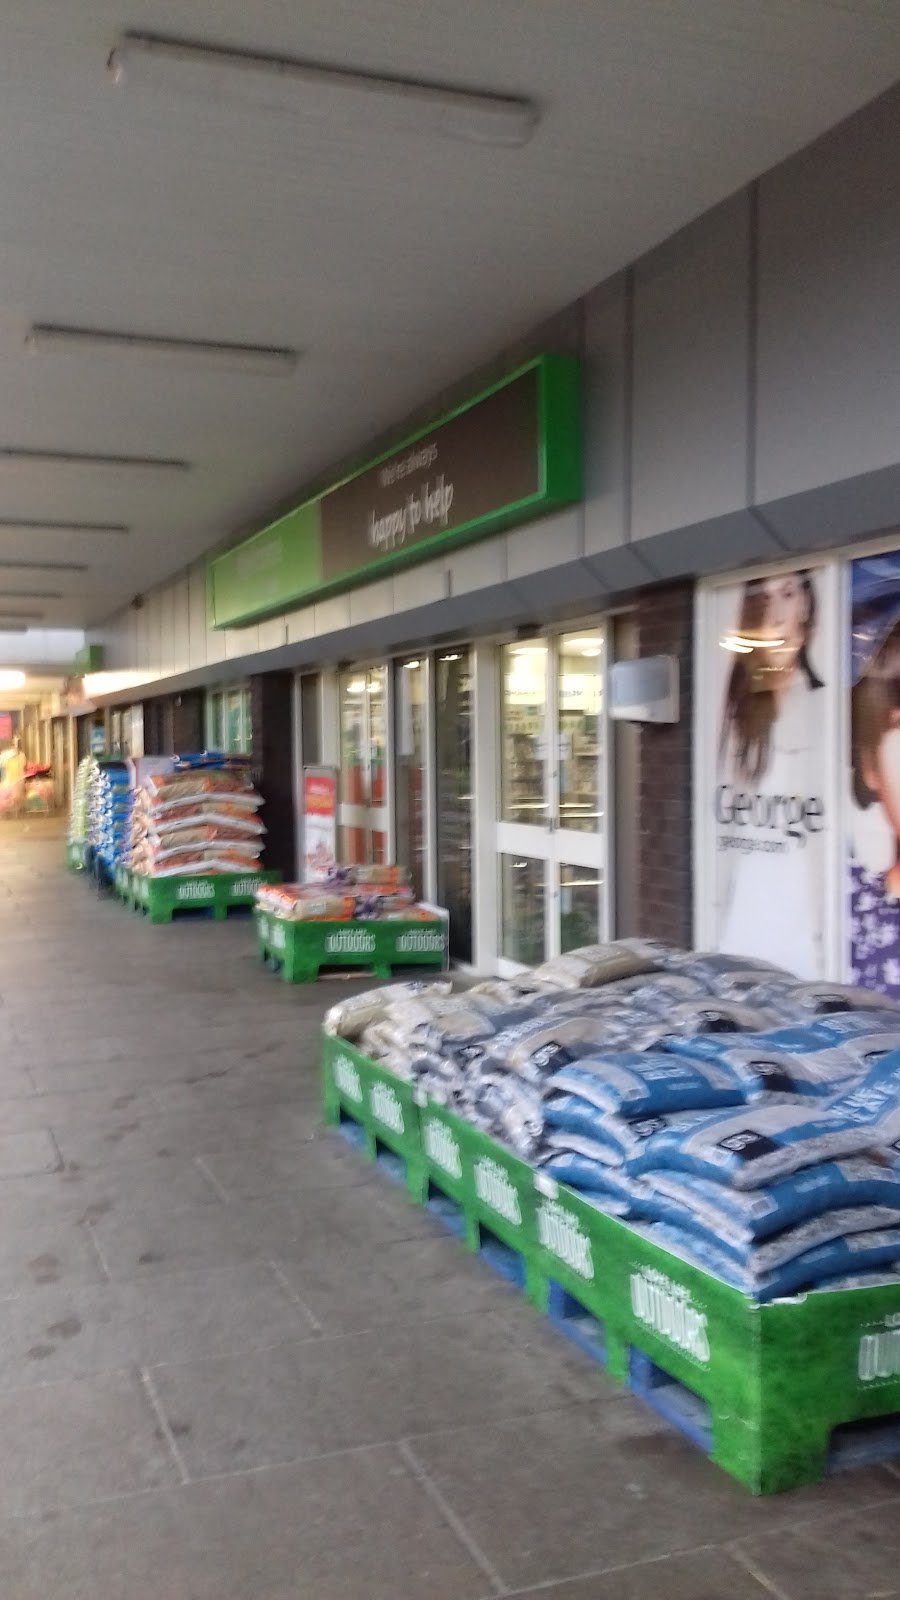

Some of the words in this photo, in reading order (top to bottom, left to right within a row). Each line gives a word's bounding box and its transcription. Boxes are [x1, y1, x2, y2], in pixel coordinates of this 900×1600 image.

[368, 508, 407, 552] happy
[406, 493, 421, 534] to
[421, 473, 454, 526] help
[715, 783, 825, 848] George
[326, 934, 376, 952] OUTDOORS
[396, 934, 446, 952] OUTDOORS
